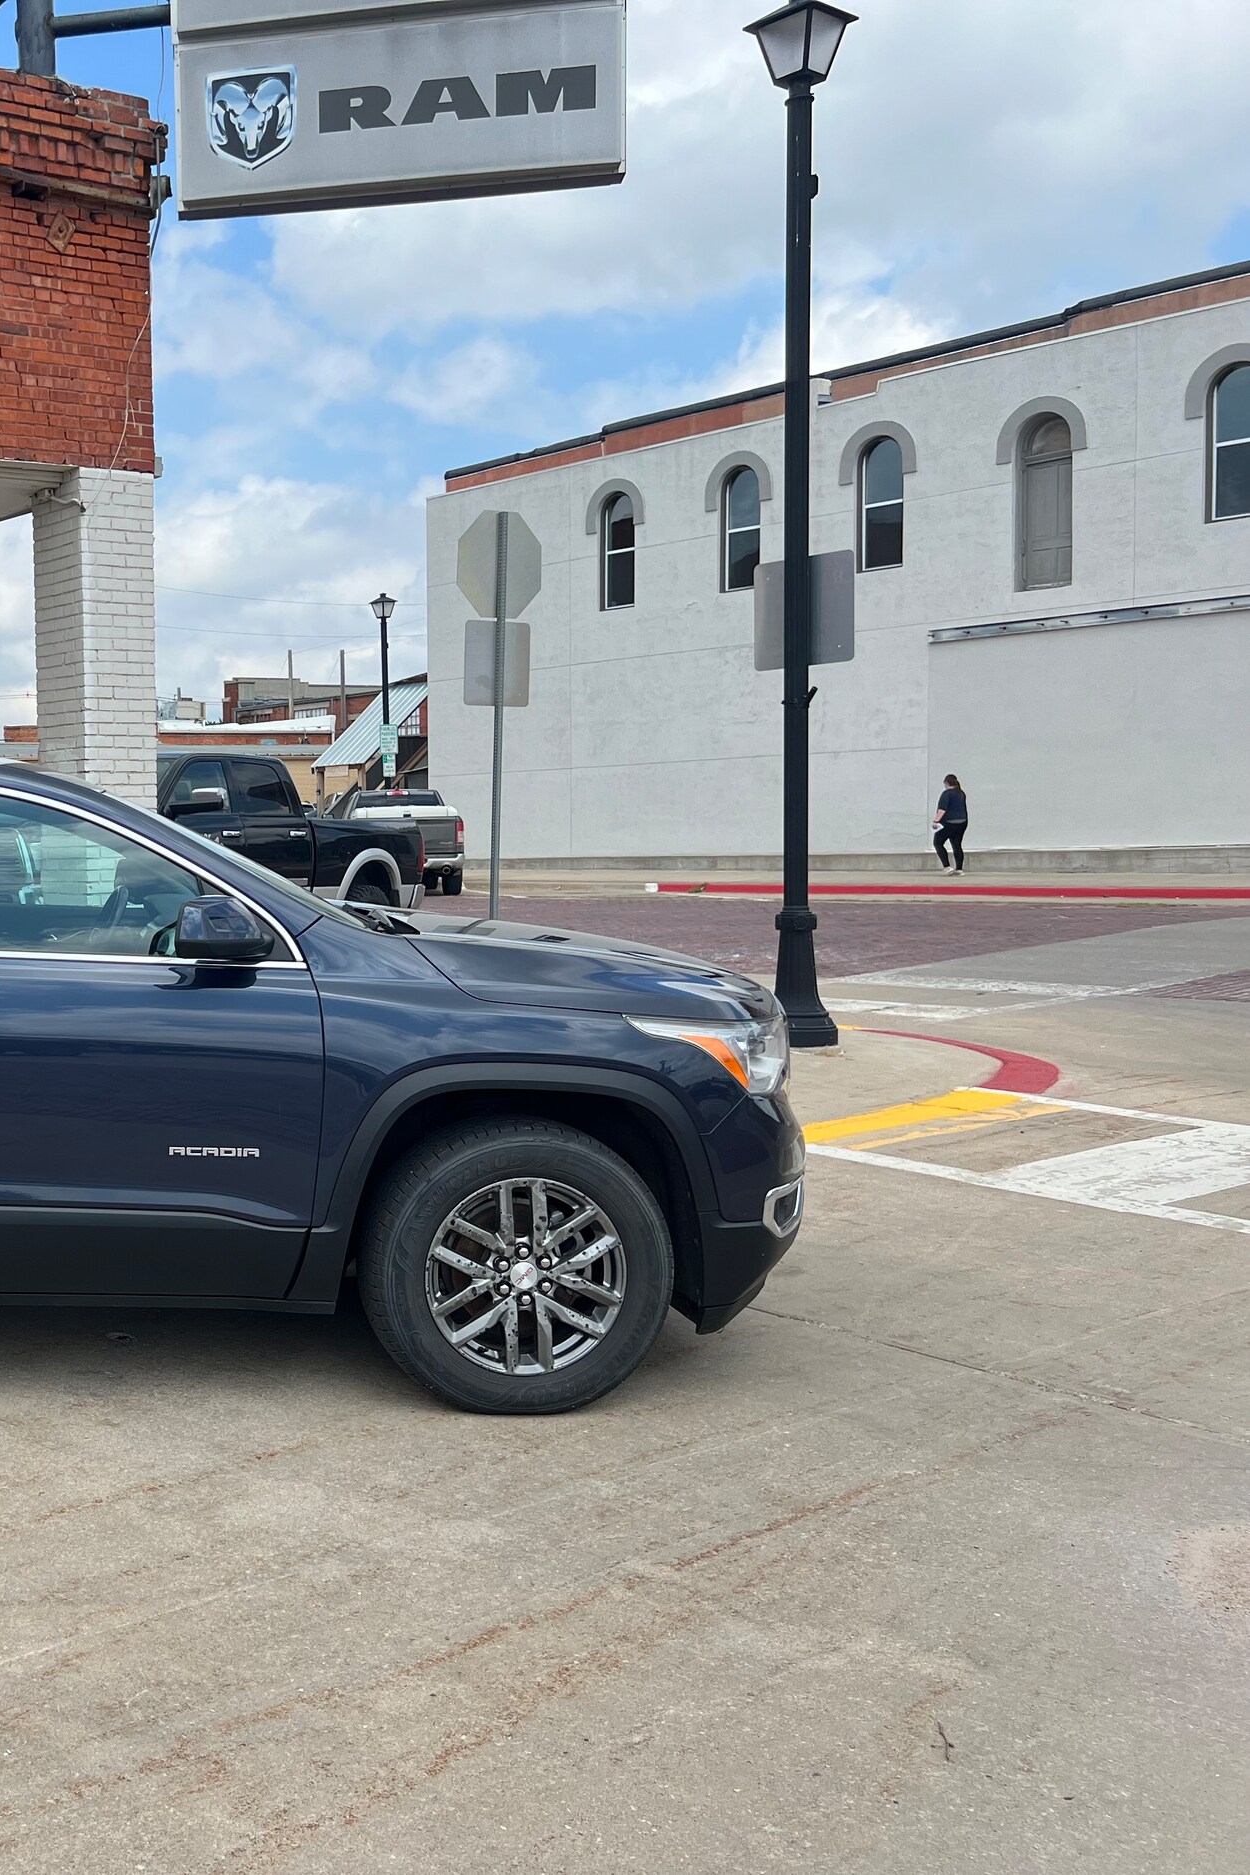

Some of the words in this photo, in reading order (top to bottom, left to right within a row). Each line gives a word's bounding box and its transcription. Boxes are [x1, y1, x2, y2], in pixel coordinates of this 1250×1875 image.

[318, 64, 597, 134] RAM
[168, 1146, 260, 1157] ACADIA
[407, 1151, 523, 1244] ASSURANCE
[514, 1266, 534, 1286] GMC
